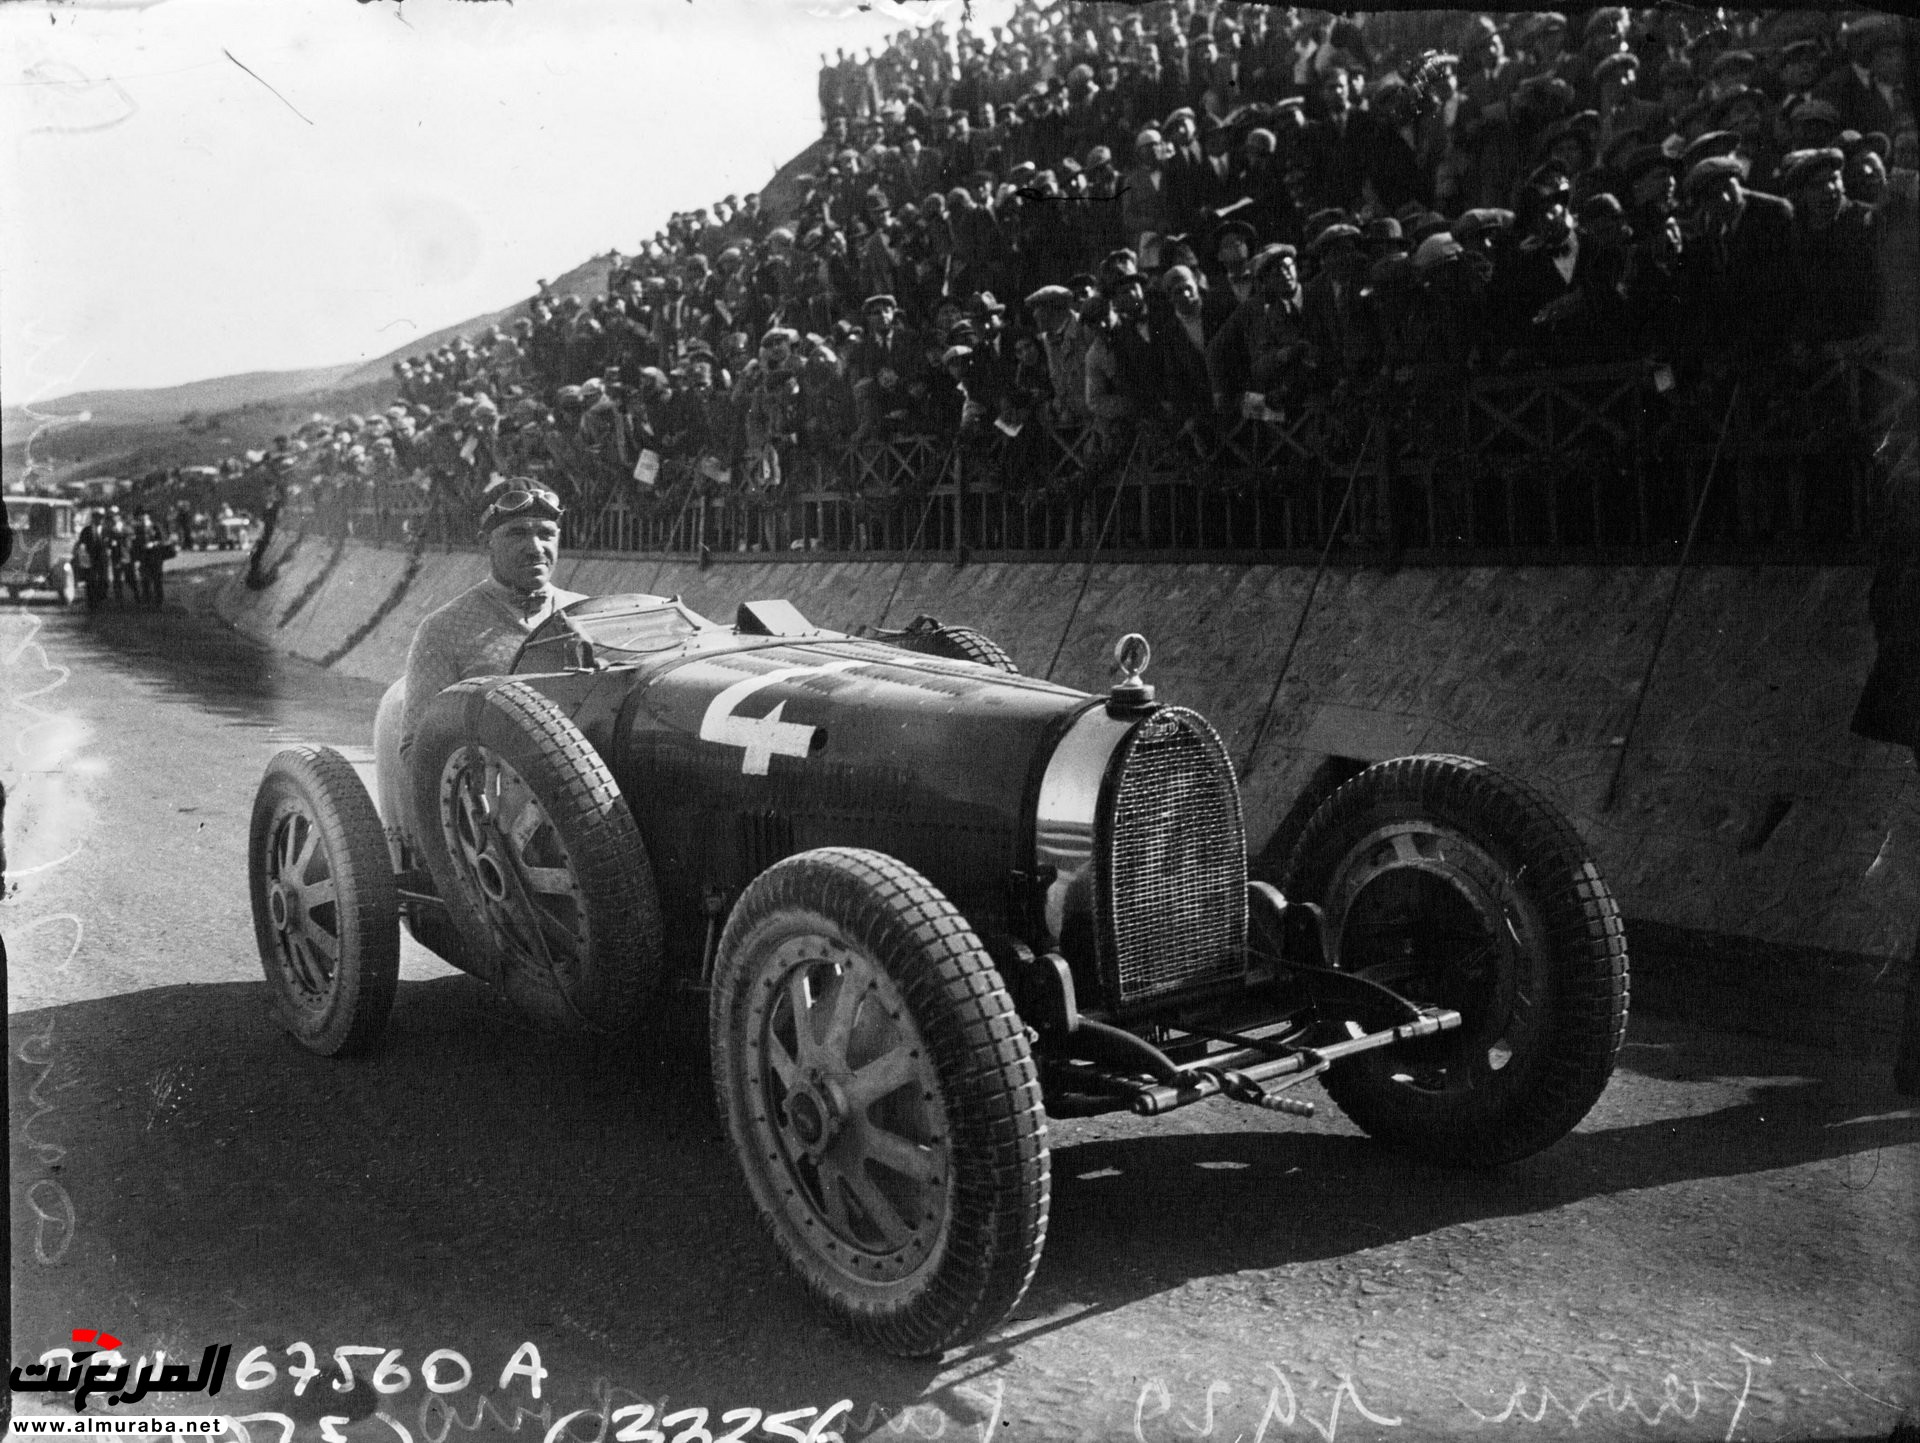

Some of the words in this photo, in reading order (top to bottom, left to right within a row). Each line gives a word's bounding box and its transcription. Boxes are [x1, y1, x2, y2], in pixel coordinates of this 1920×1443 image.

[700, 660, 874, 776] 4
[235, 1341, 472, 1396] 67560
[499, 1341, 549, 1399] A
